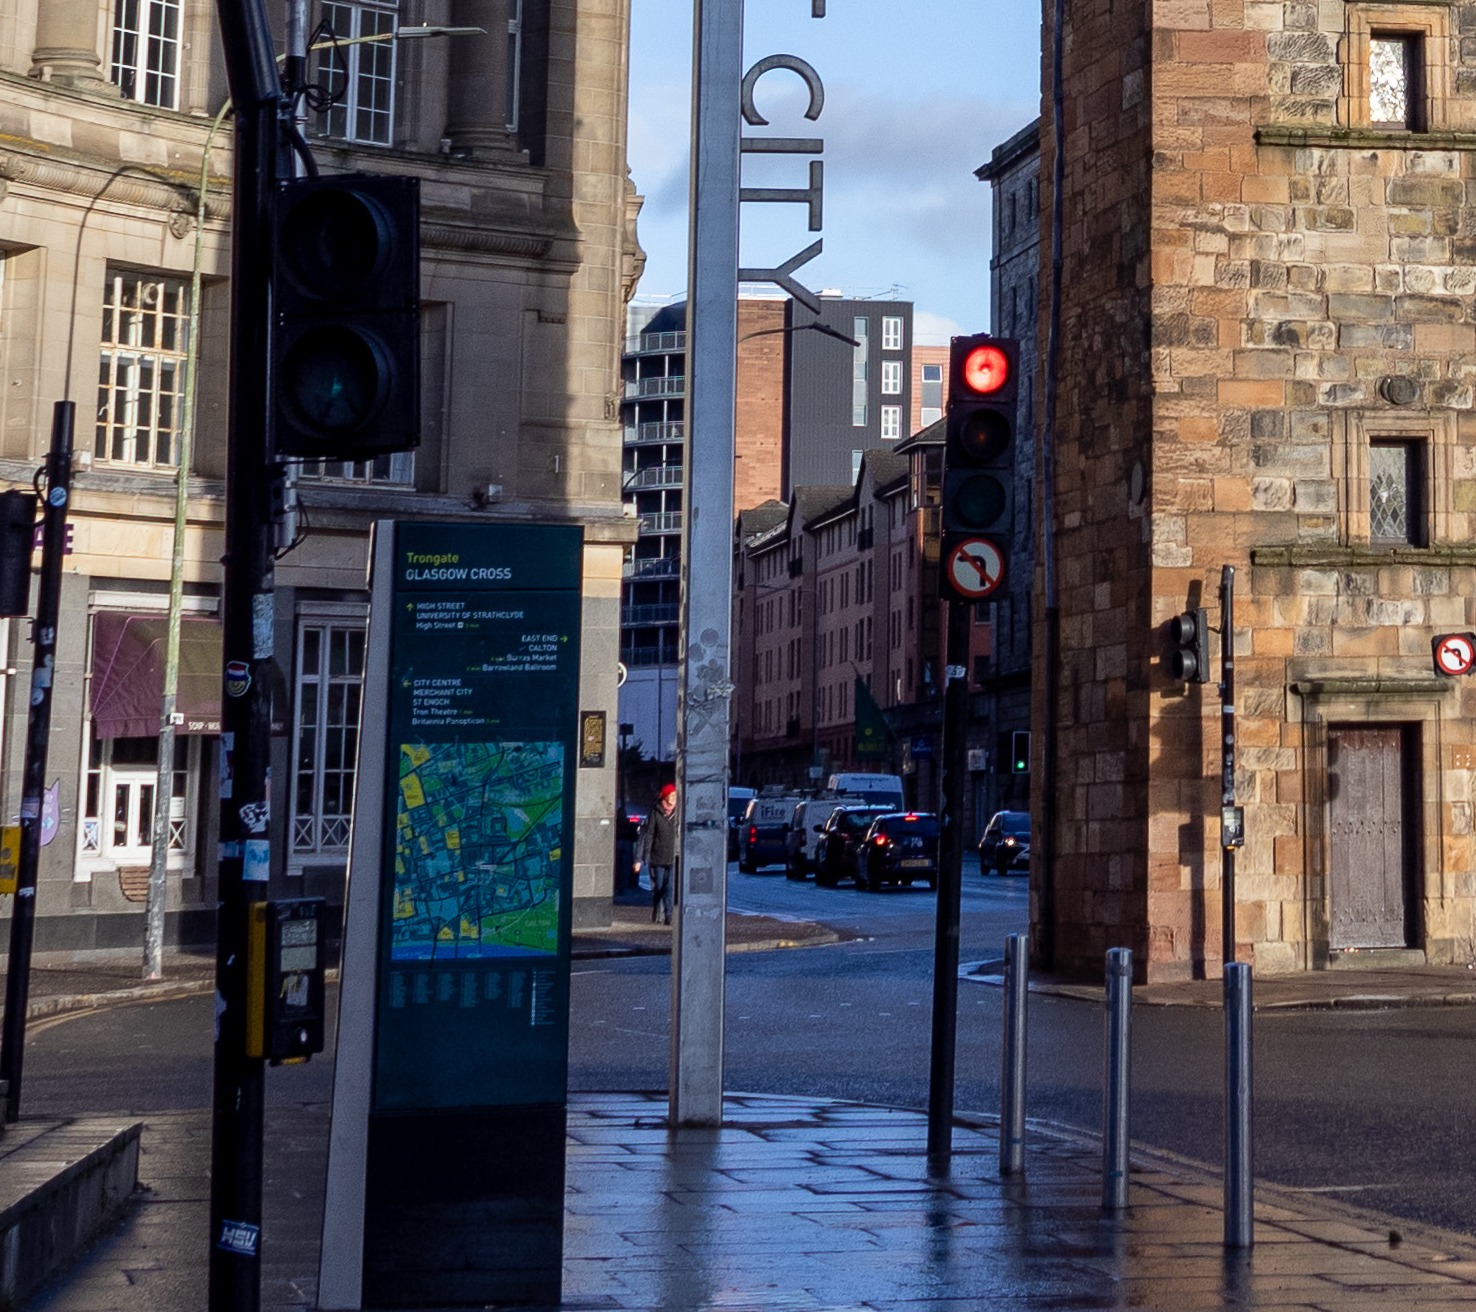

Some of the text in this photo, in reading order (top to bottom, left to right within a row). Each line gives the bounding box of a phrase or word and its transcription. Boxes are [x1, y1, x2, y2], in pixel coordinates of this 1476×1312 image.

[738, 52, 824, 316] CITY
[406, 552, 459, 565] Trongate
[406, 568, 512, 581] GLASGOW CROSS
[416, 602, 465, 610] HIGH STREET
[416, 611, 524, 619] UNIVERSITY OF STRATHCLYDE
[416, 621, 433, 630] High
[434, 621, 455, 629] Street
[522, 634, 558, 642] EAST END
[528, 644, 557, 652] CALTON
[532, 653, 557, 661] Market
[525, 663, 557, 671] Ballroom
[413, 678, 462, 686] CITY CENTRE
[413, 688, 455, 696] MERCHANT
[413, 698, 450, 706] ST ENOCH
